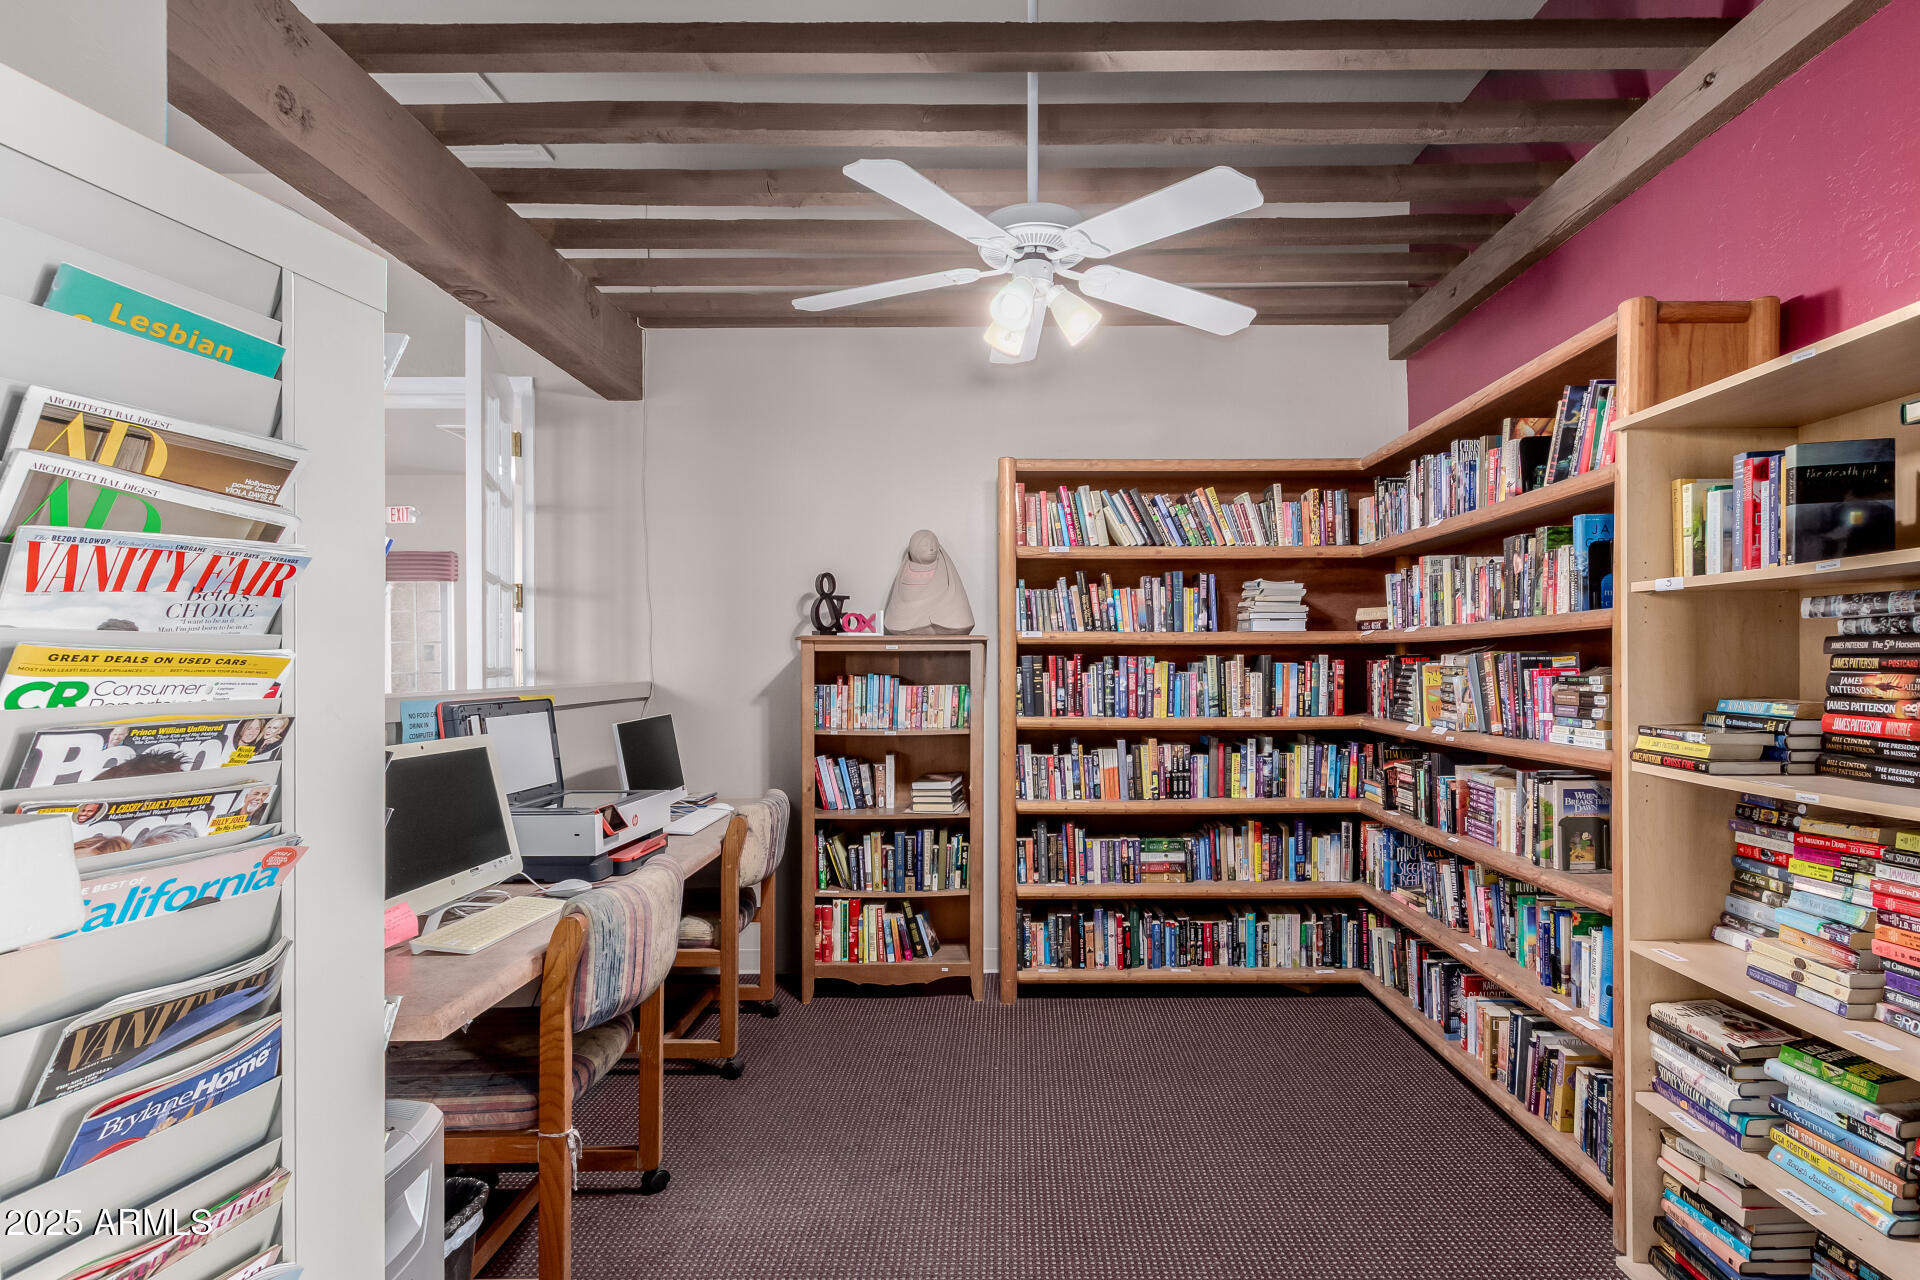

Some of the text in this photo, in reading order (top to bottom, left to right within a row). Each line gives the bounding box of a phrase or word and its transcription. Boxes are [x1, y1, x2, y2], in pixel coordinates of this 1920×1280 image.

[108, 302, 233, 362] Lesbian
[46, 395, 173, 430] ARCHITECTURAL DIGEST
[44, 412, 168, 477] AD
[1806, 465, 1877, 478] the death pit
[32, 462, 160, 497] ARCHITECTURAL DIGEST
[245, 479, 280, 490] Hollywood
[225, 486, 246, 496] VIOLA
[248, 490, 268, 500] DAVIS
[231, 482, 277, 495] power couple
[5, 479, 162, 543] AD
[390, 507, 410, 522] EXIT
[51, 534, 77, 543] BEZOS
[79, 537, 111, 545] BLOWUP
[175, 544, 207, 553] ENDGAME
[268, 555, 299, 564] THERANOS
[25, 541, 297, 598] VANITY FAIR
[811, 572, 850, 631] &
[165, 602, 259, 619] CHOICE
[1831, 641, 1844, 649] JAMES
[1844, 641, 1869, 649] PATTERSON
[1884, 640, 1894, 650] 5th
[48, 653, 248, 666] GREAT DEALS ON USED CARS
[1832, 657, 1849, 668] JAMES
[1849, 657, 1879, 669] PATTERSON
[1840, 676, 1863, 685] JAMES
[94, 680, 207, 697] Consumer
[1830, 685, 1873, 694] PATTERSON
[4, 681, 90, 710] CR
[1826, 700, 1896, 713] JAMES PATTERSON
[130, 724, 224, 737] Prince William Unfiltered
[1832, 717, 1913, 736] JAMES PATTERSON INVISIBLE
[1843, 737, 1871, 745] CLINTON
[1384, 750, 1398, 759] TIM
[1843, 744, 1875, 753] PATTERSON
[1890, 750, 1917, 758] MISSING
[1663, 756, 1695, 770] CROSS FIRE
[1838, 760, 1867, 770] CLINTON
[1838, 767, 1872, 778] PATTERSON
[1887, 774, 1915, 784] MISSING
[1565, 797, 1593, 805] BREAKS
[1574, 791, 1598, 799] WHEN
[108, 795, 213, 814] A COSBY STAR'S TRAGIC DEATH
[211, 816, 245, 826] BILLY JOEL
[1804, 836, 1825, 846] IMITATION
[1831, 840, 1847, 849] DEATH
[1426, 850, 1444, 858] ALL
[92, 877, 147, 896] BEST OF
[1749, 969, 1789, 991] NORA ROBERTS
[1845, 1073, 1867, 1086] MOMENT
[97, 1049, 272, 1141] BrylaneHome
[1850, 1083, 1867, 1094] TRUTH
[1777, 1103, 1792, 1118] LISA
[1792, 1111, 1836, 1140] SCOTTOLINE
[1772, 1130, 1845, 1183] LISA SCOTTOLINE DIRTY
[1785, 1123, 1898, 1195] LISA SCOTTOLINE DEAD RINGER
[1786, 1159, 1836, 1194] Rough Justice
